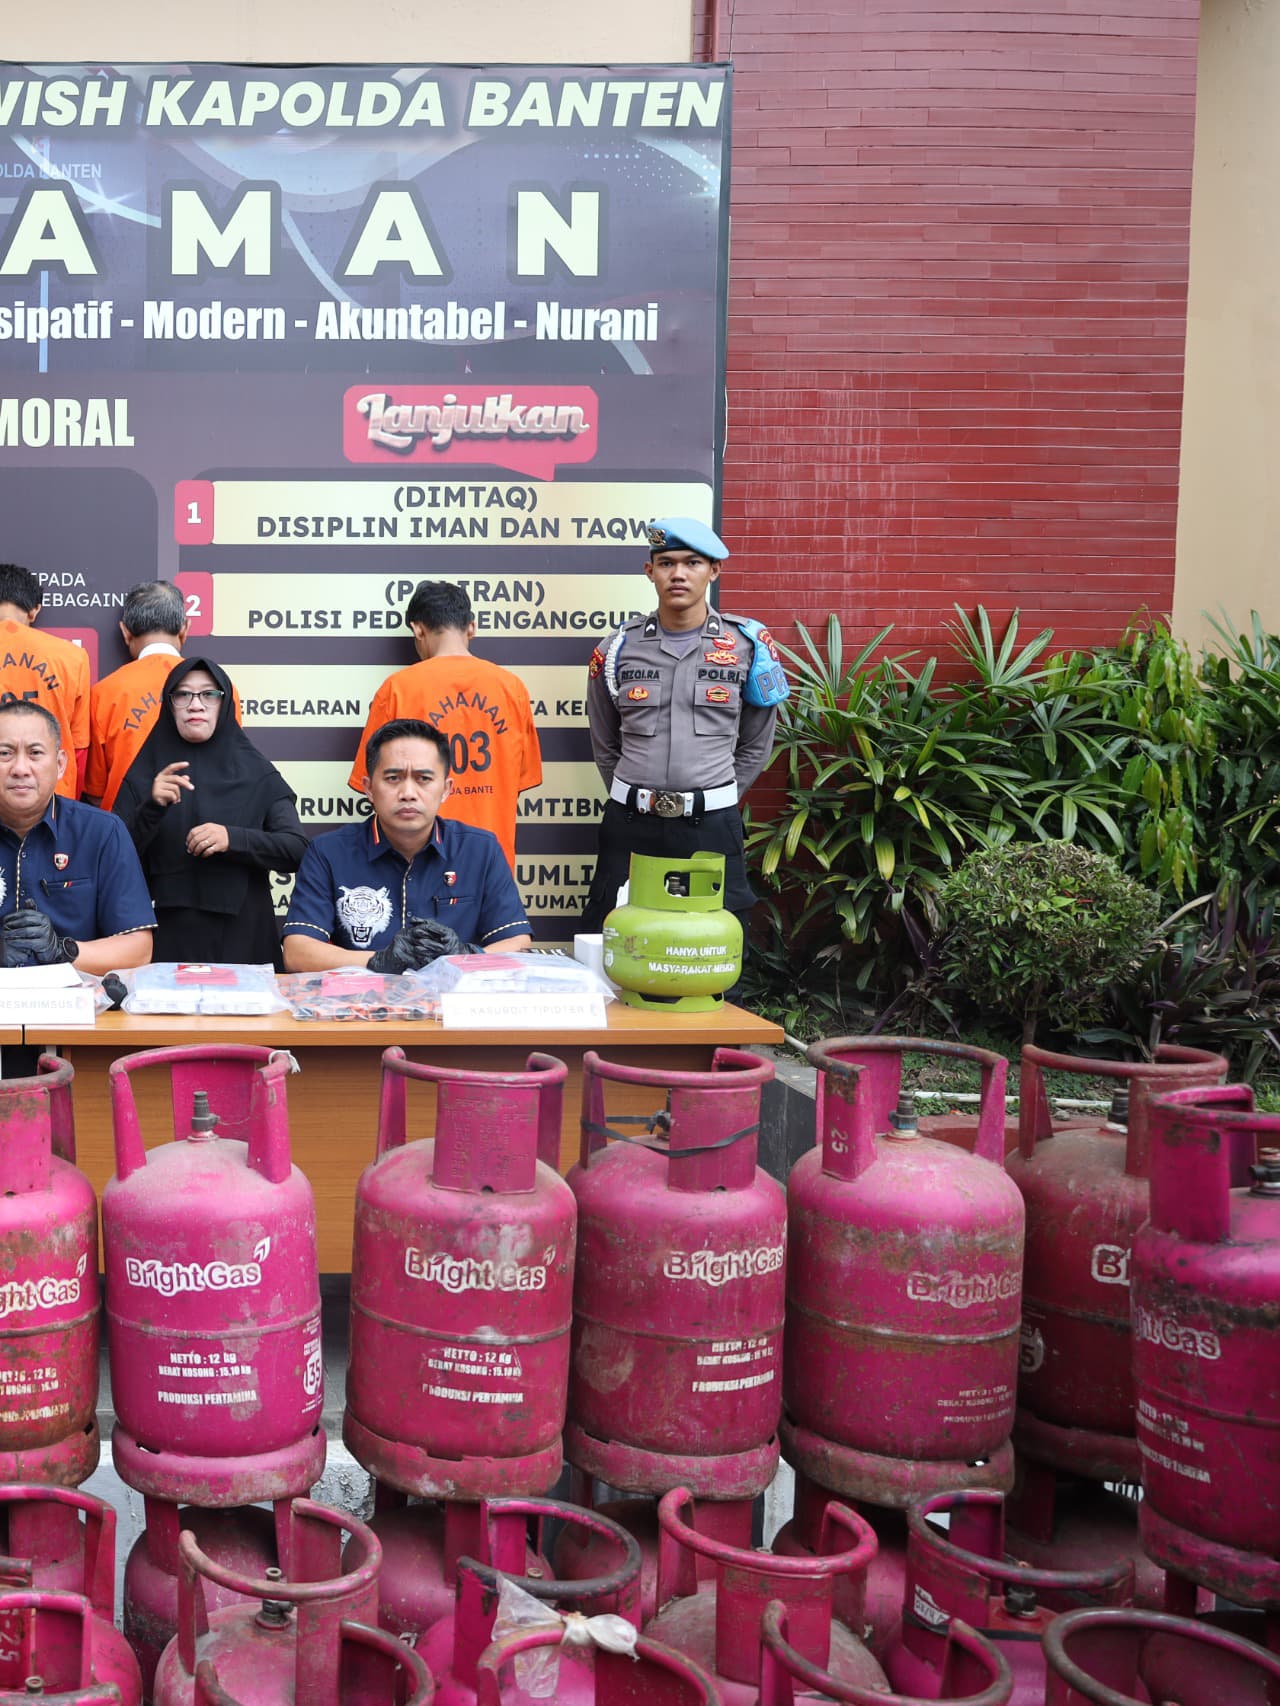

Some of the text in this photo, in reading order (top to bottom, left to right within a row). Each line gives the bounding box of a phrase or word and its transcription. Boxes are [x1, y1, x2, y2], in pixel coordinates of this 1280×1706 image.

[145, 81, 447, 127] KAPOLDA
[469, 82, 722, 128] BANTEN
[39, 163, 102, 179] BANTEN
[143, 301, 286, 340] Modern
[316, 302, 505, 341] Akuntabel
[535, 302, 659, 342] Nurani
[357, 393, 590, 449] Lanjutkan
[393, 486, 538, 512] (DIMTAQ)
[187, 502, 657, 540] 1 DISIPLIN IMAN DAN TAQW
[41, 593, 129, 606] EBAGAIN
[385, 580, 546, 607] (PRAN)
[186, 596, 201, 617] 2
[247, 610, 343, 630] POLISI
[698, 668, 741, 683] POLRI
[429, 691, 508, 736] AHANAN
[444, 731, 492, 775] 03
[665, 946, 698, 957] HANYA
[649, 962, 712, 975] MASYARAKAT
[170, 1352, 201, 1364] NETTO
[208, 1353, 220, 1364] 12
[444, 1347, 478, 1361] NETTO
[157, 1390, 257, 1405] PRODUKSI PERTAMINA
